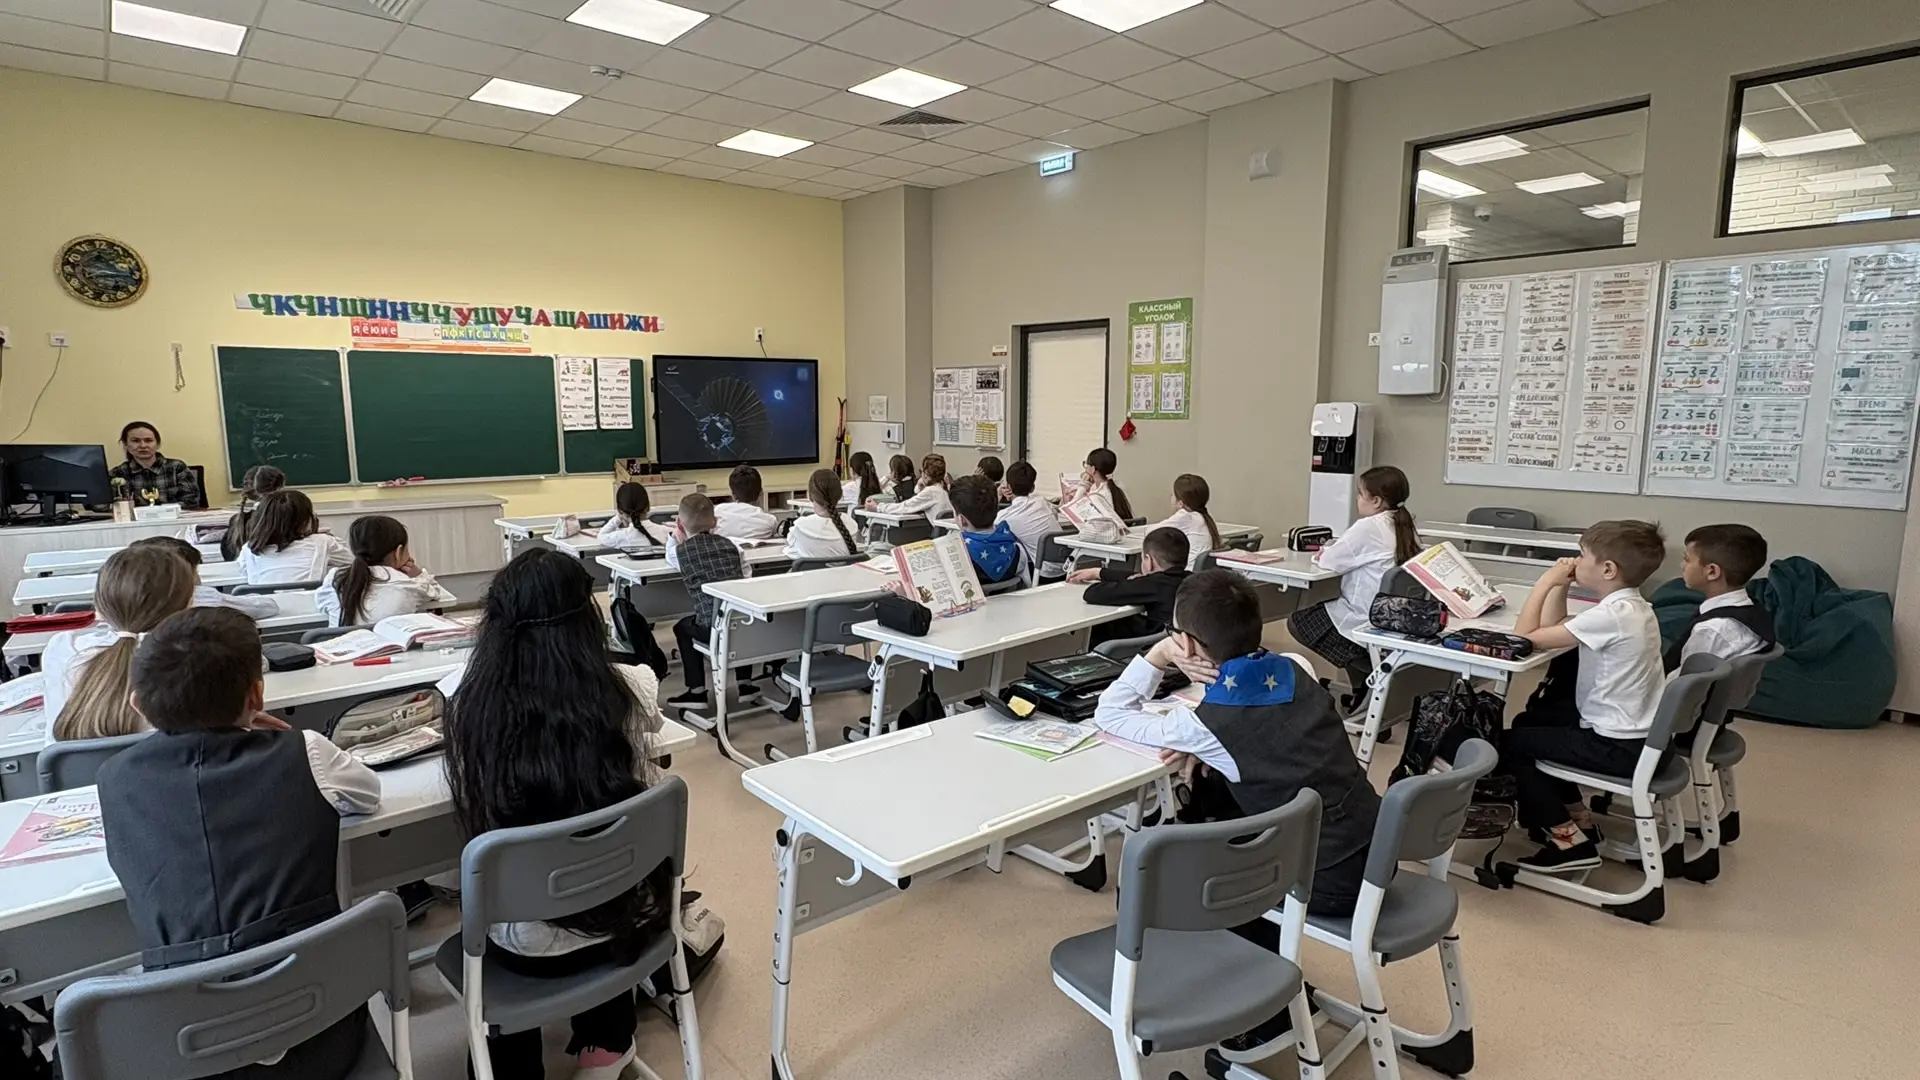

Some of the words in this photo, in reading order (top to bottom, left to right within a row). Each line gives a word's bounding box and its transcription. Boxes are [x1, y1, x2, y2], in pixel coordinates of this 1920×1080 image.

[1139, 301, 1182, 313] КЛАССНЫЙ
[1145, 313, 1175, 322] УГОЛОК
[1852, 447, 1882, 455] МАССА
